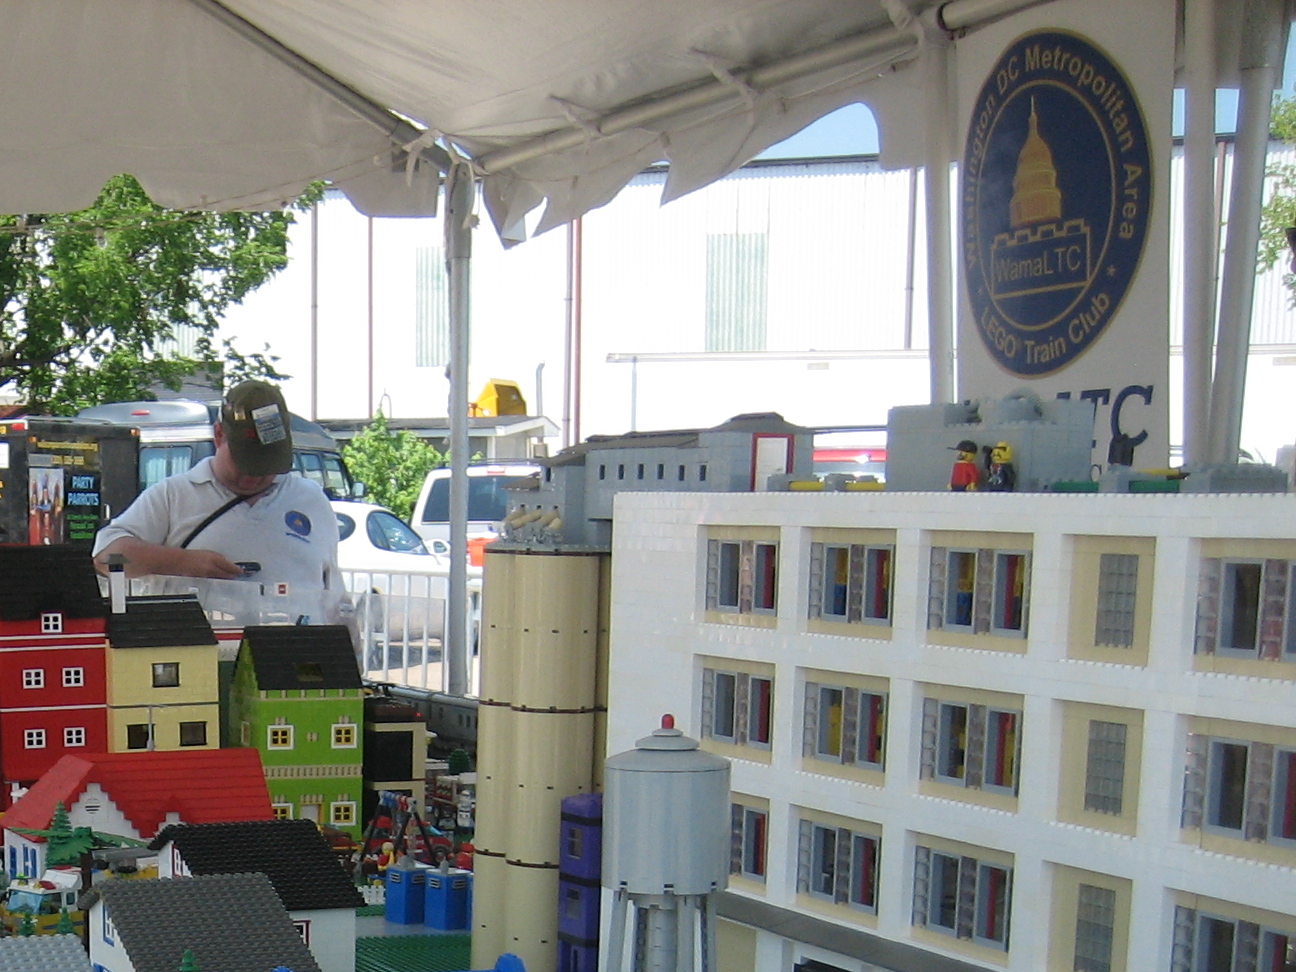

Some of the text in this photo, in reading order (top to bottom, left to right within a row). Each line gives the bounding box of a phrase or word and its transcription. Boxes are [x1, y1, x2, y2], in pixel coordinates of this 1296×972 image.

[997, 56, 1020, 95] DC
[1025, 45, 1134, 152] Metropolitan
[1119, 163, 1143, 240] Area
[995, 245, 1081, 283] WamaLTC
[1024, 335, 1067, 364] Train
[1068, 292, 1111, 344] Club
